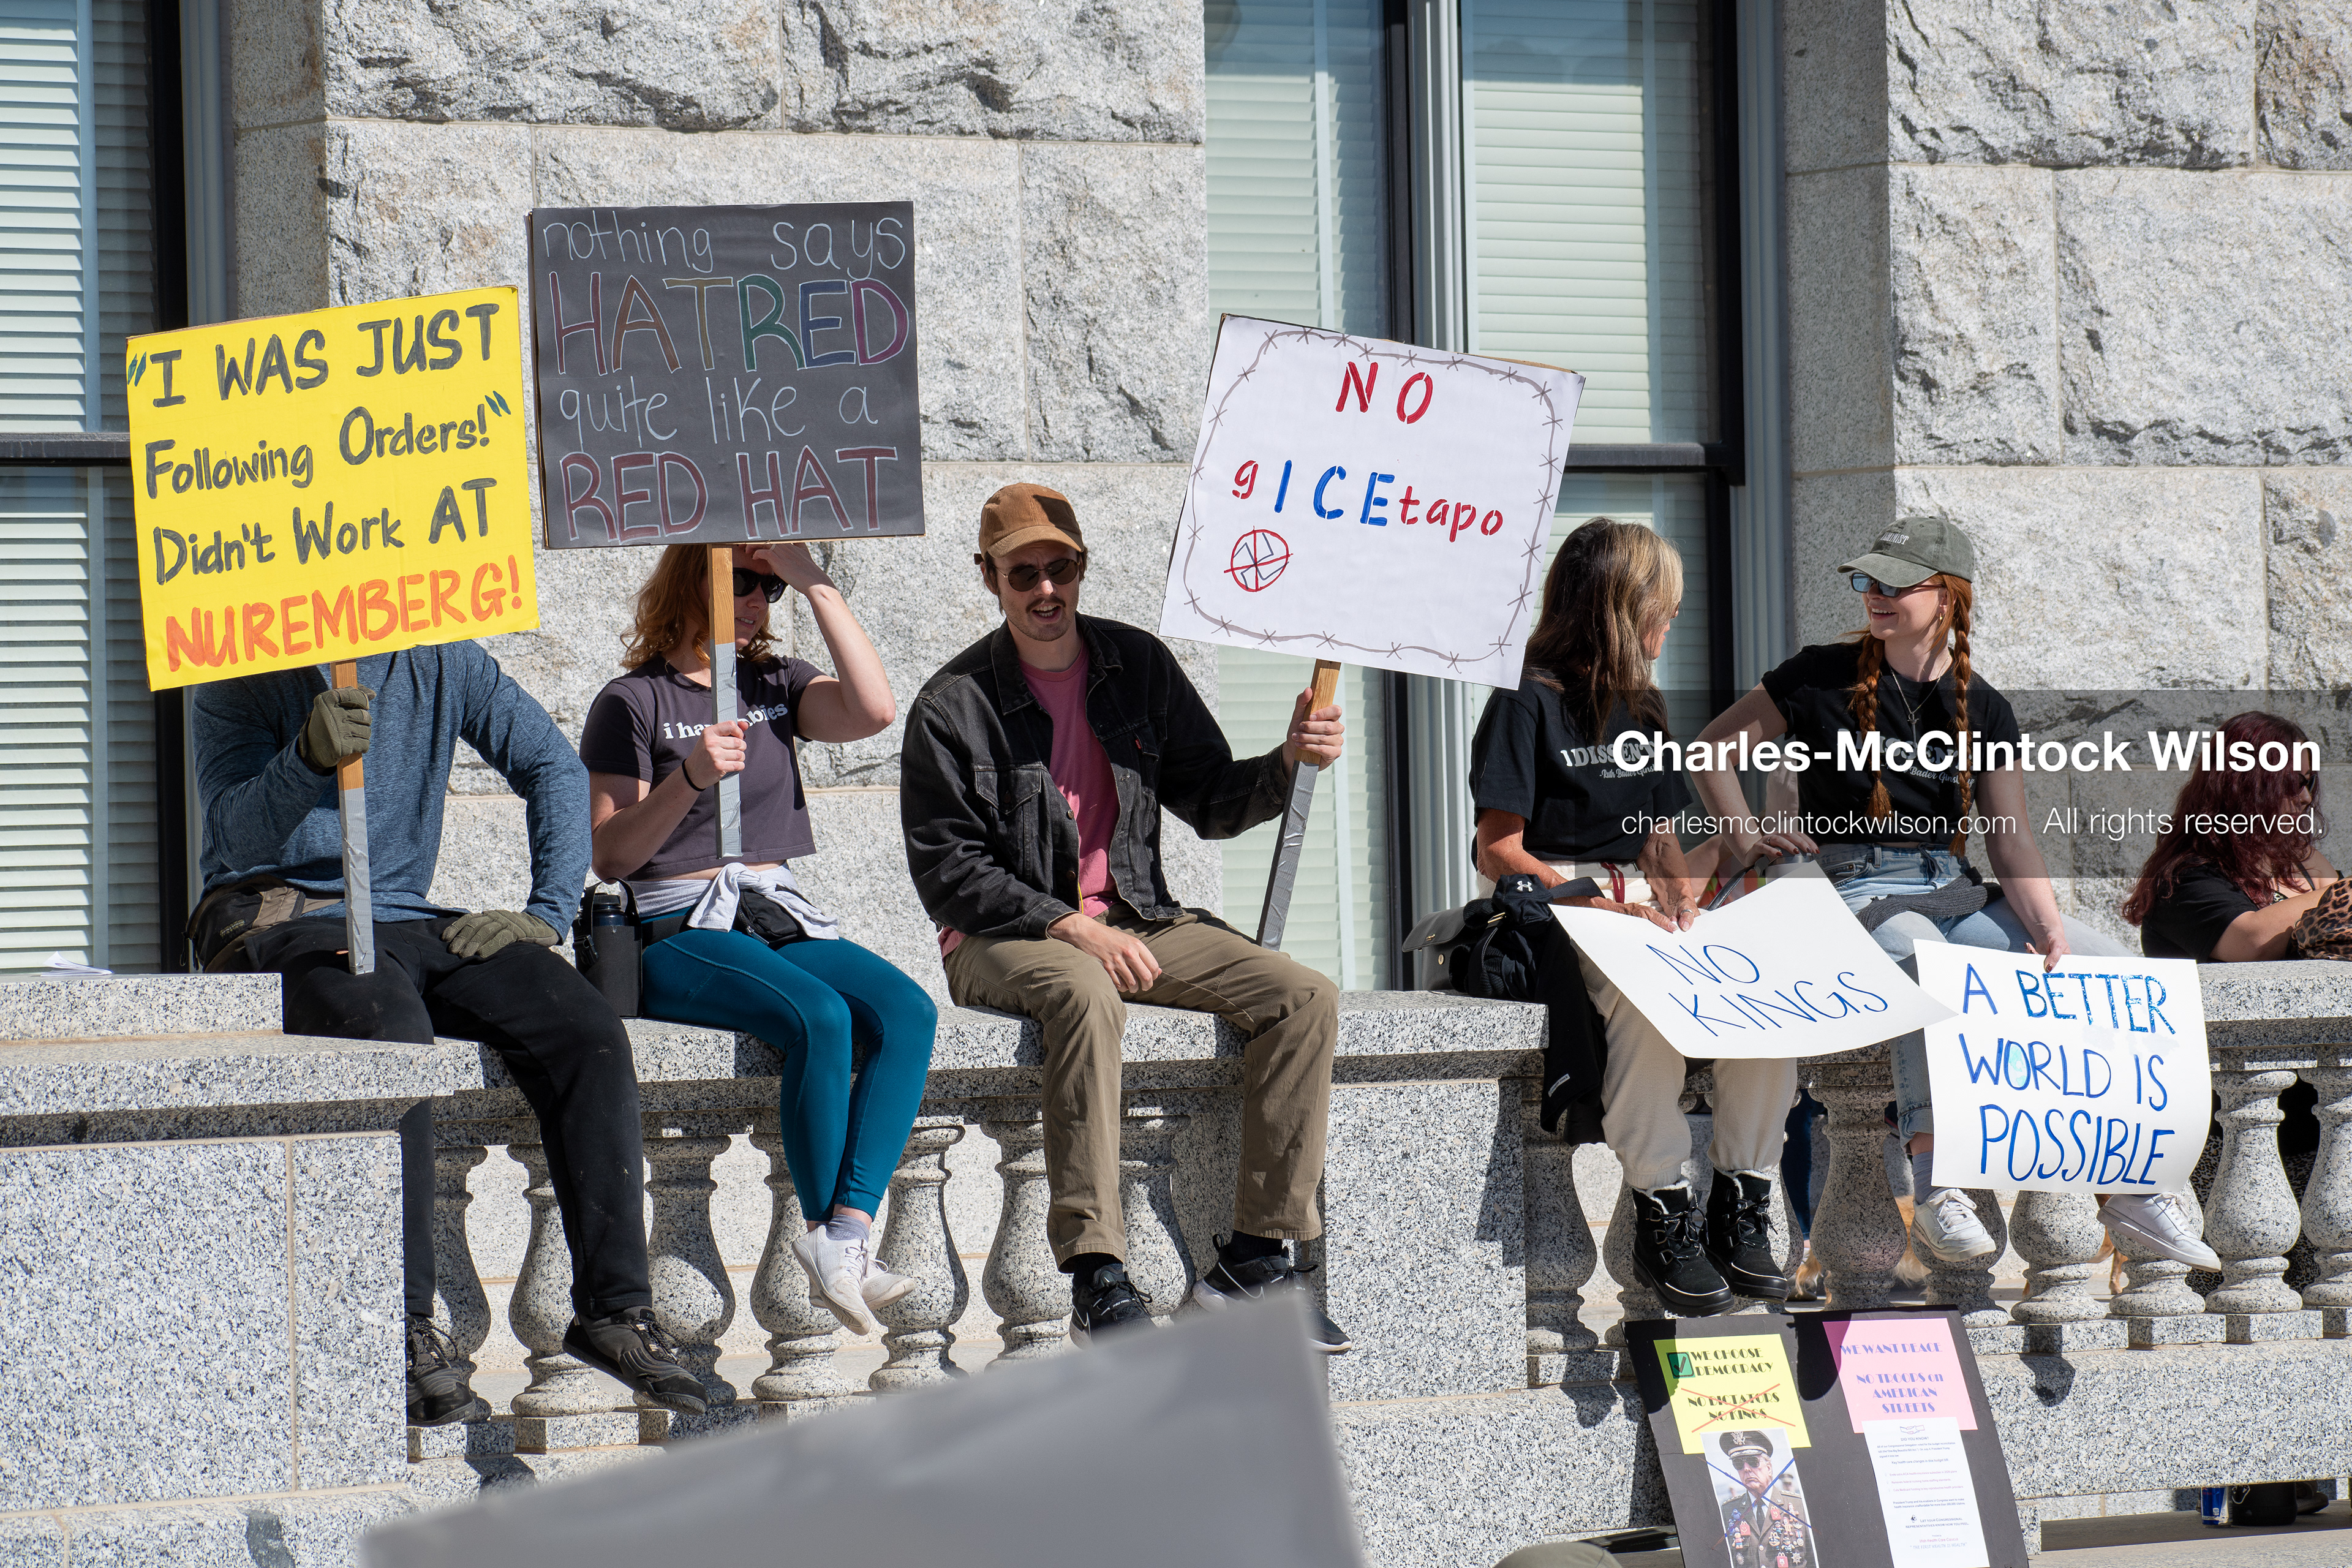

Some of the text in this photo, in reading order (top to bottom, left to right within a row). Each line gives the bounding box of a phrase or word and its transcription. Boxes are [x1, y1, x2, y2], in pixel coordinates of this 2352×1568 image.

[543, 210, 906, 280] nothing says
[216, 329, 329, 401] WAS
[356, 304, 500, 377] JUST
[549, 271, 909, 375] HATRED
[560, 376, 878, 452] quite like a
[1335, 361, 1433, 424] NO
[145, 391, 511, 499] Following Orders!"
[560, 445, 898, 545] RED HAT
[153, 477, 497, 585] Didn't Work AT
[1880, 532, 1909, 545] FEMINIST
[166, 554, 522, 673] NUREMBERG!
[1560, 750, 1573, 766] I
[1646, 944, 1760, 986] NO
[1668, 971, 1888, 1037] KINGS
[1962, 963, 2176, 1034] A BETTER
[1959, 1033, 2168, 1112] WORLD IS
[1980, 1103, 2175, 1185] POSSIBLE
[1691, 1348, 1763, 1361] WE CHOOSE
[1695, 1362, 1773, 1376] DEMOCRACY
[1840, 1343, 1943, 1355] WE WANT PEACE
[1856, 1373, 1943, 1384] NO TROOPS on
[1687, 1392, 1780, 1408] NO DICTATORS
[1708, 1408, 1767, 1421] NO KINGS
[1873, 1387, 1938, 1398] AMERICAN
[1882, 1402, 1936, 1414] STREETS
